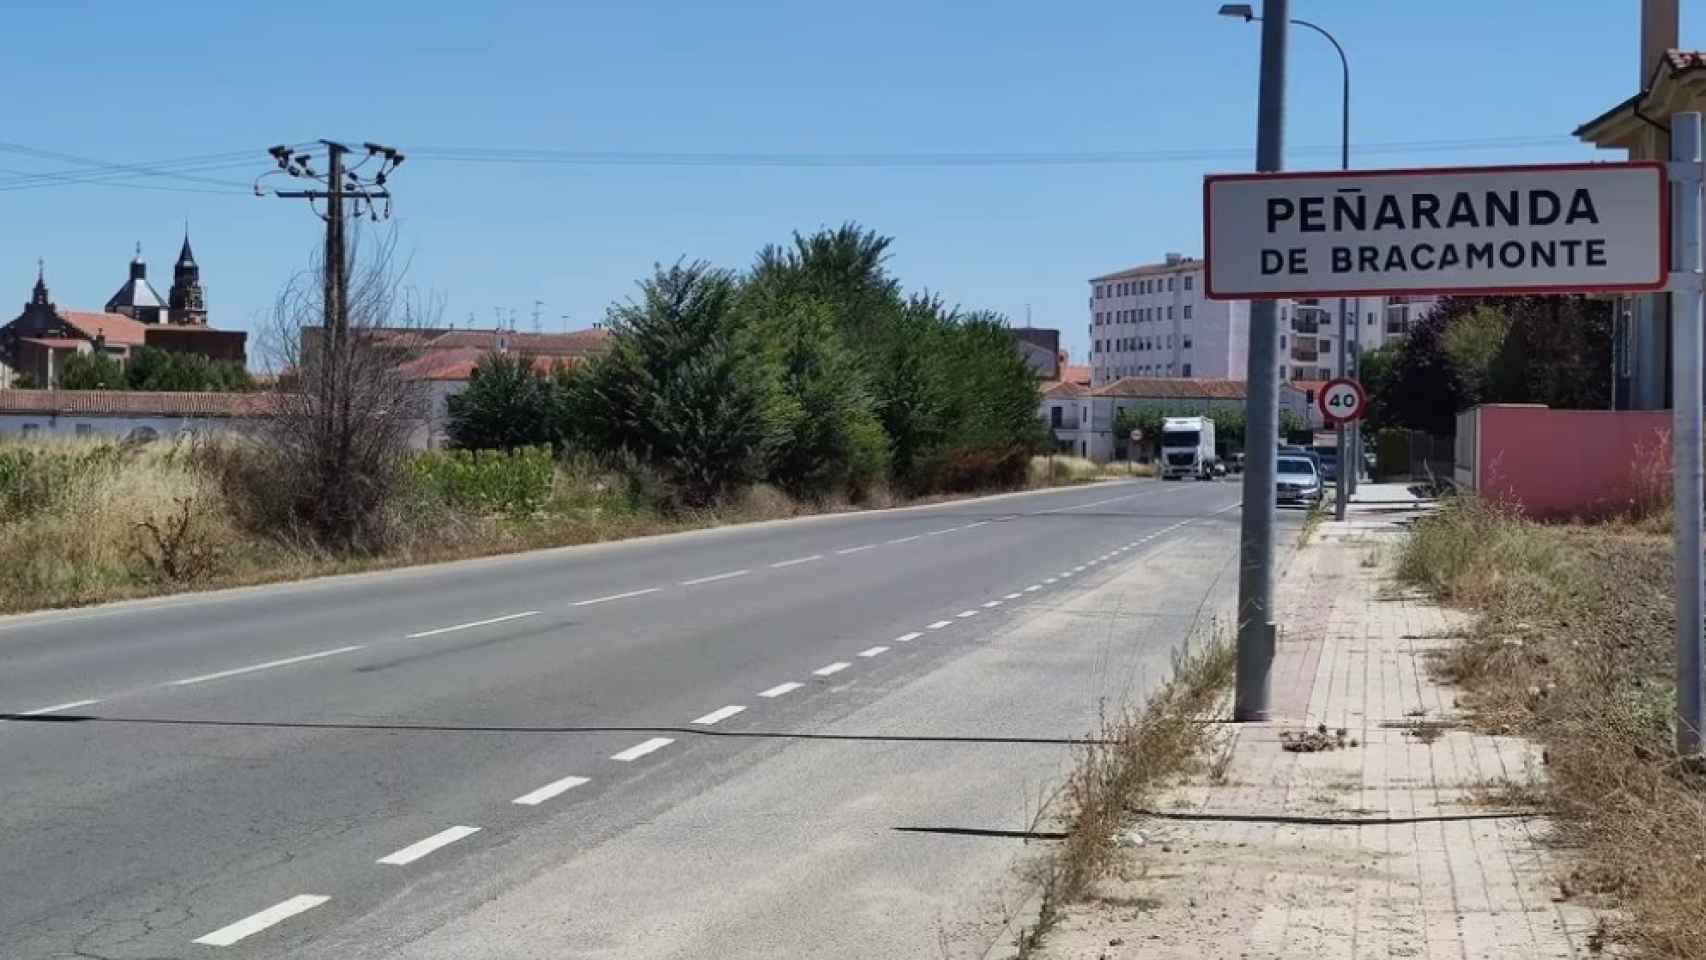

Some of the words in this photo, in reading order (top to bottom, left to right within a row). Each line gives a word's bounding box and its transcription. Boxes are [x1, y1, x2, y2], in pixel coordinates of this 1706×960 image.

[1266, 188, 1599, 233] PEÑARANDA
[1260, 248, 1308, 275] DE
[1331, 239, 1607, 274] BRACAMONTE
[1329, 394, 1356, 408] 40
